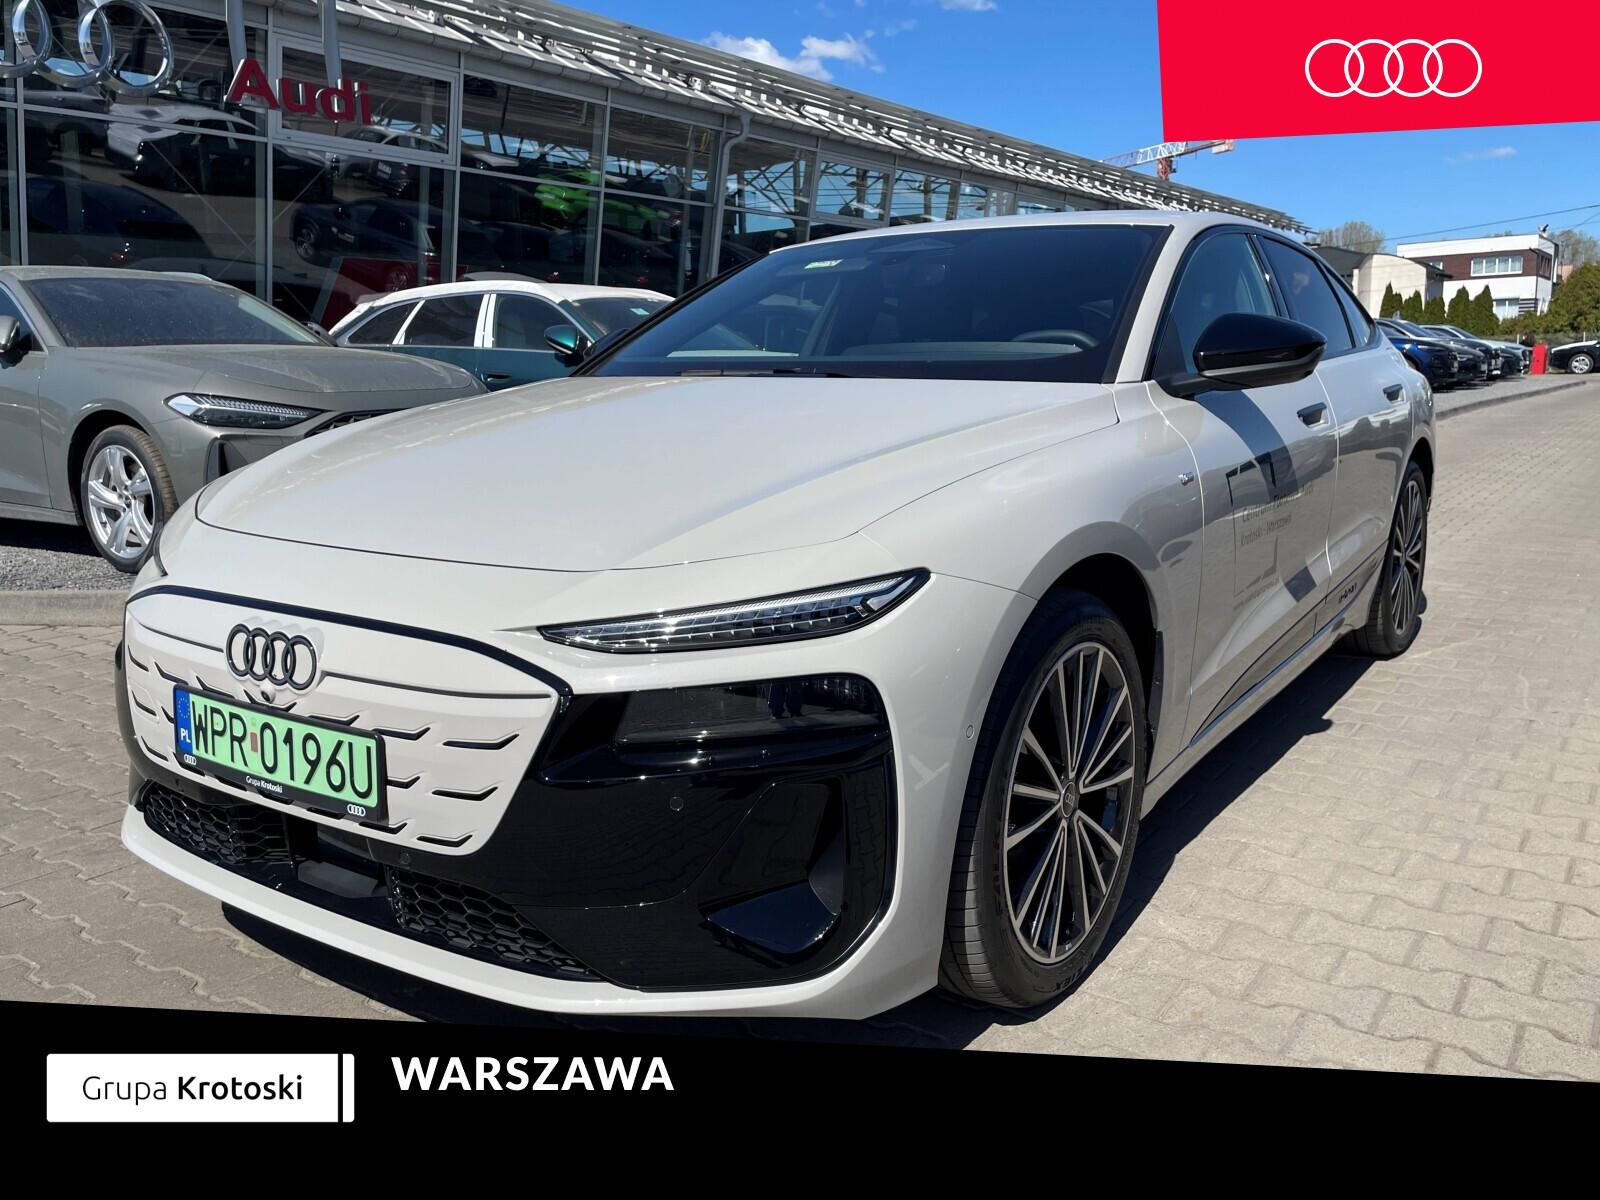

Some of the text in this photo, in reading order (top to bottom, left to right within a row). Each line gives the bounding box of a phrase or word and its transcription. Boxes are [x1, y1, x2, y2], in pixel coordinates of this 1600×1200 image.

[227, 58, 371, 125] Audi
[180, 727, 191, 744] PL
[191, 700, 373, 799] WPR 0196U
[245, 775, 283, 793] Grupa Krotoski
